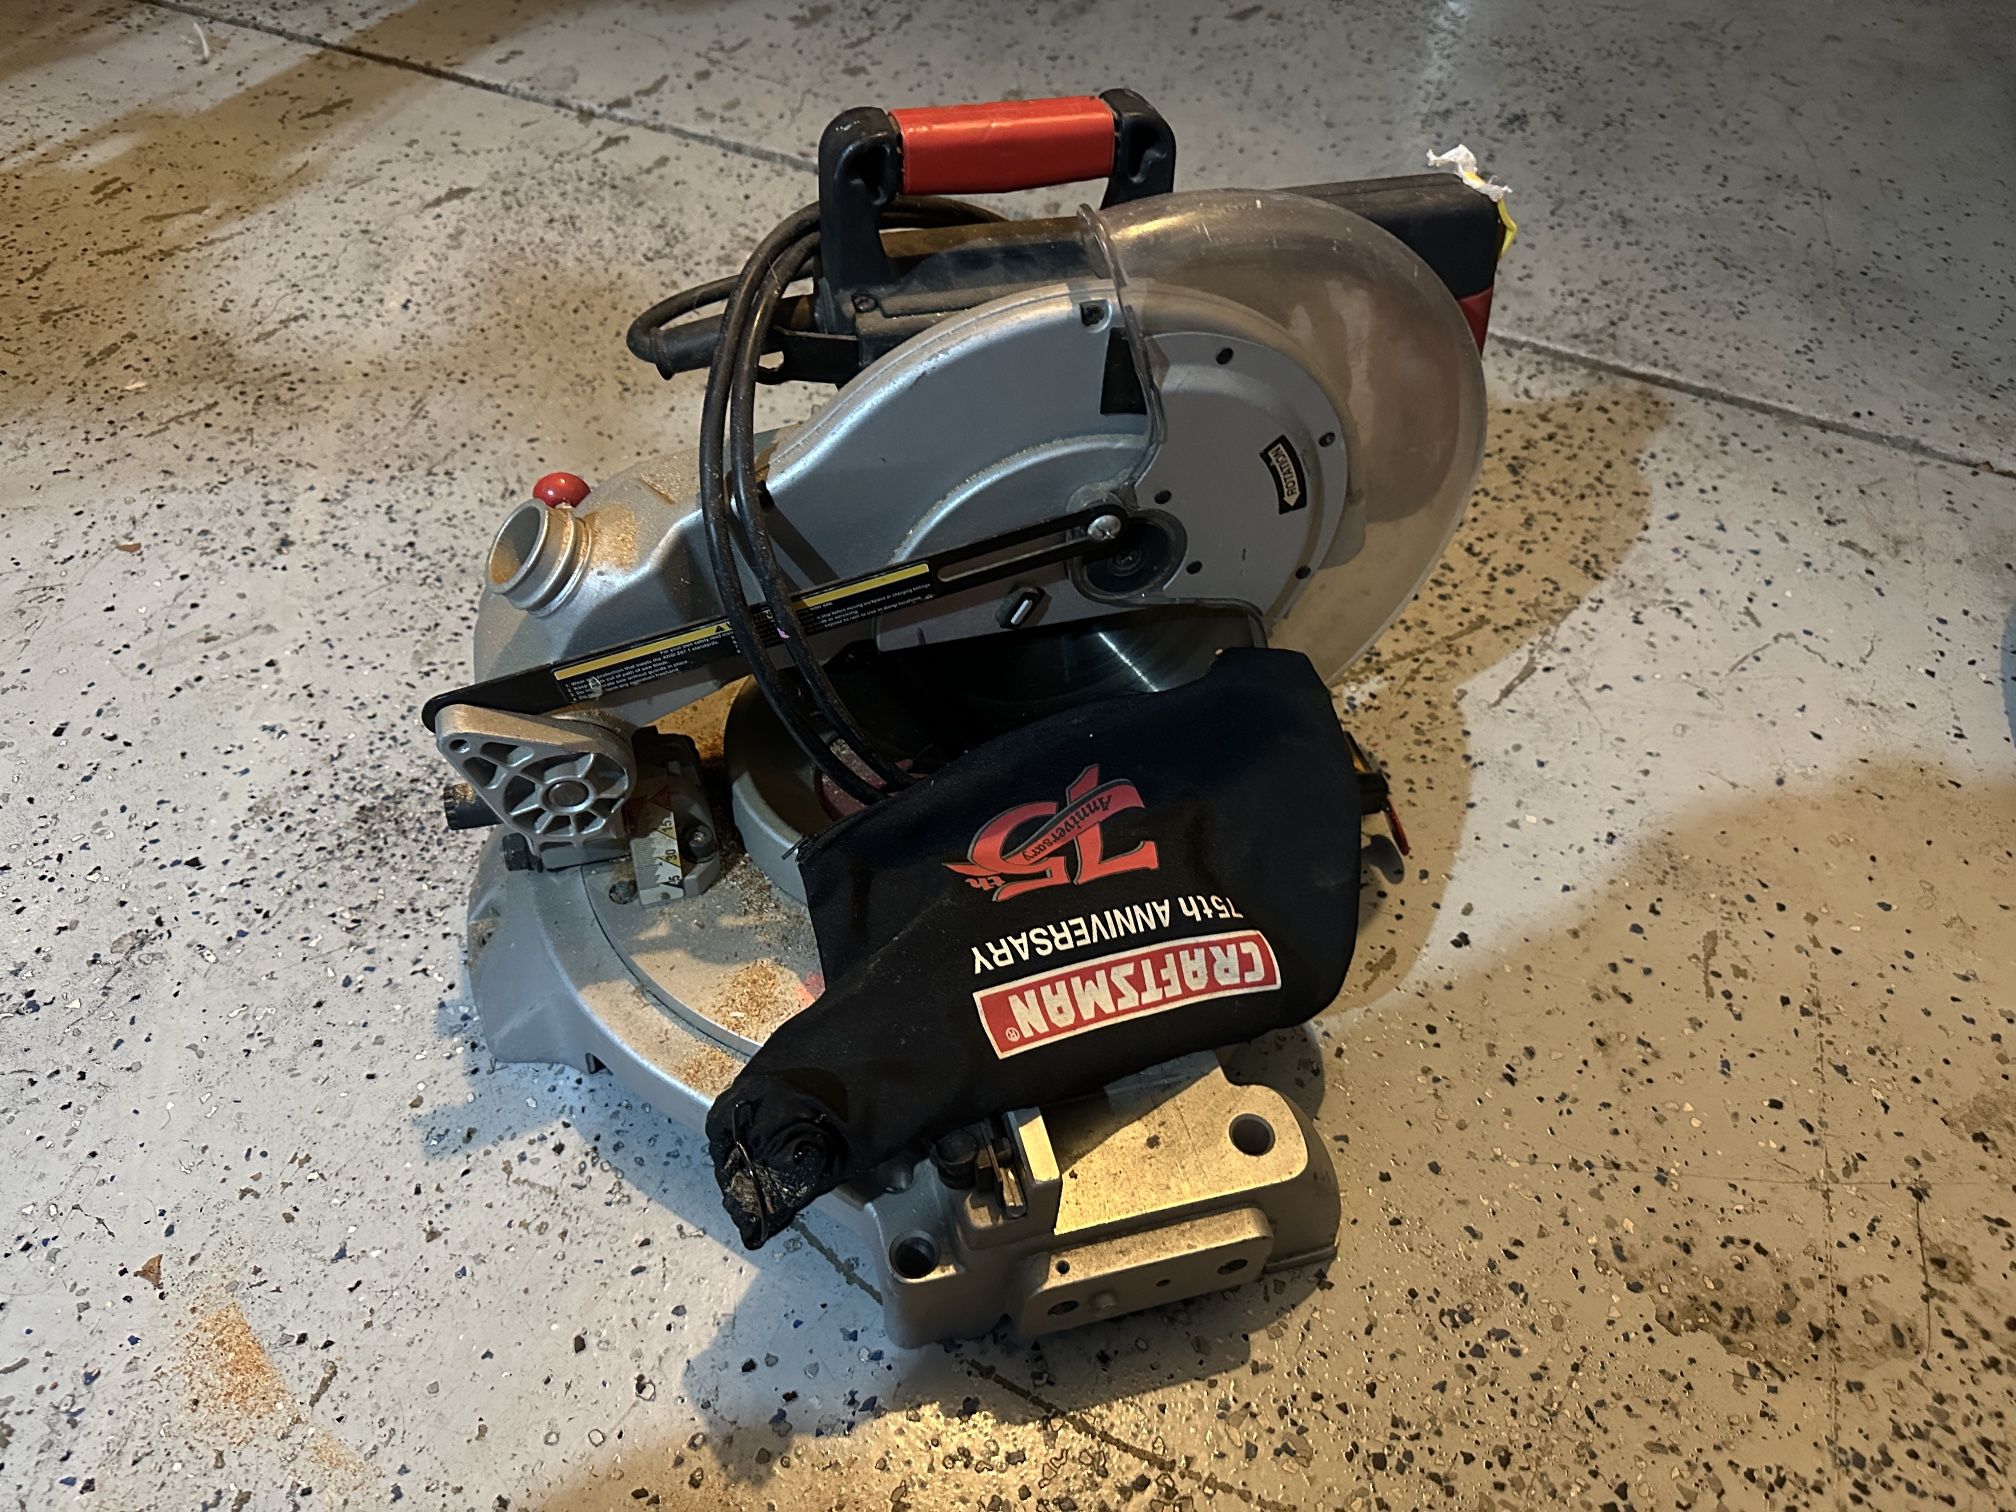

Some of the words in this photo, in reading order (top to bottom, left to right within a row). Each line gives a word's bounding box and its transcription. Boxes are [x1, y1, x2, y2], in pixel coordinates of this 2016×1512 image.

[1271, 447, 1298, 497] ROTATION
[1022, 794, 1113, 863] Anniversary
[665, 849, 678, 861] 30
[1177, 896, 1244, 922] 75th
[970, 899, 1171, 975] ANNIVERSARY
